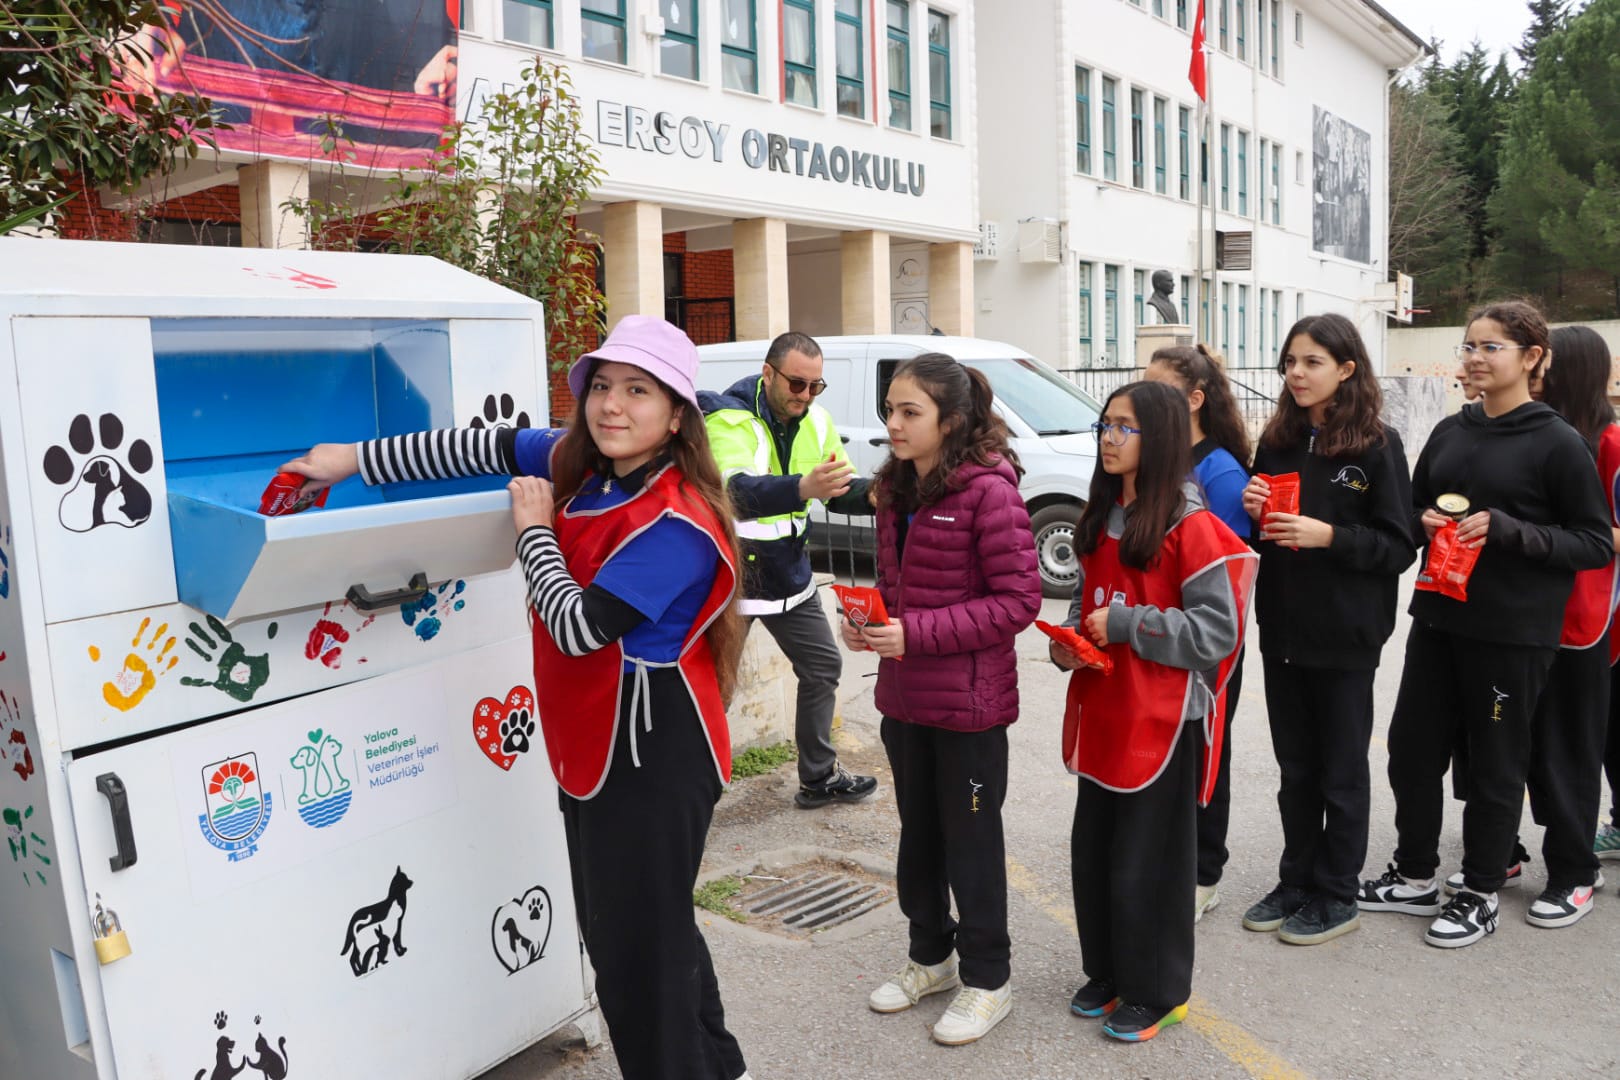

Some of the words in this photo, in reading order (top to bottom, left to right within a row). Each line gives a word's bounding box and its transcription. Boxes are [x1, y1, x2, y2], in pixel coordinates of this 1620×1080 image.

[597, 99, 731, 163] ERSOY
[741, 128, 925, 197] ORTAOKULU
[364, 728, 398, 744] Yalova
[365, 734, 417, 759] Belediyesi
[368, 752, 414, 774] Veteriner
[369, 762, 425, 789] Müdürlüğü
